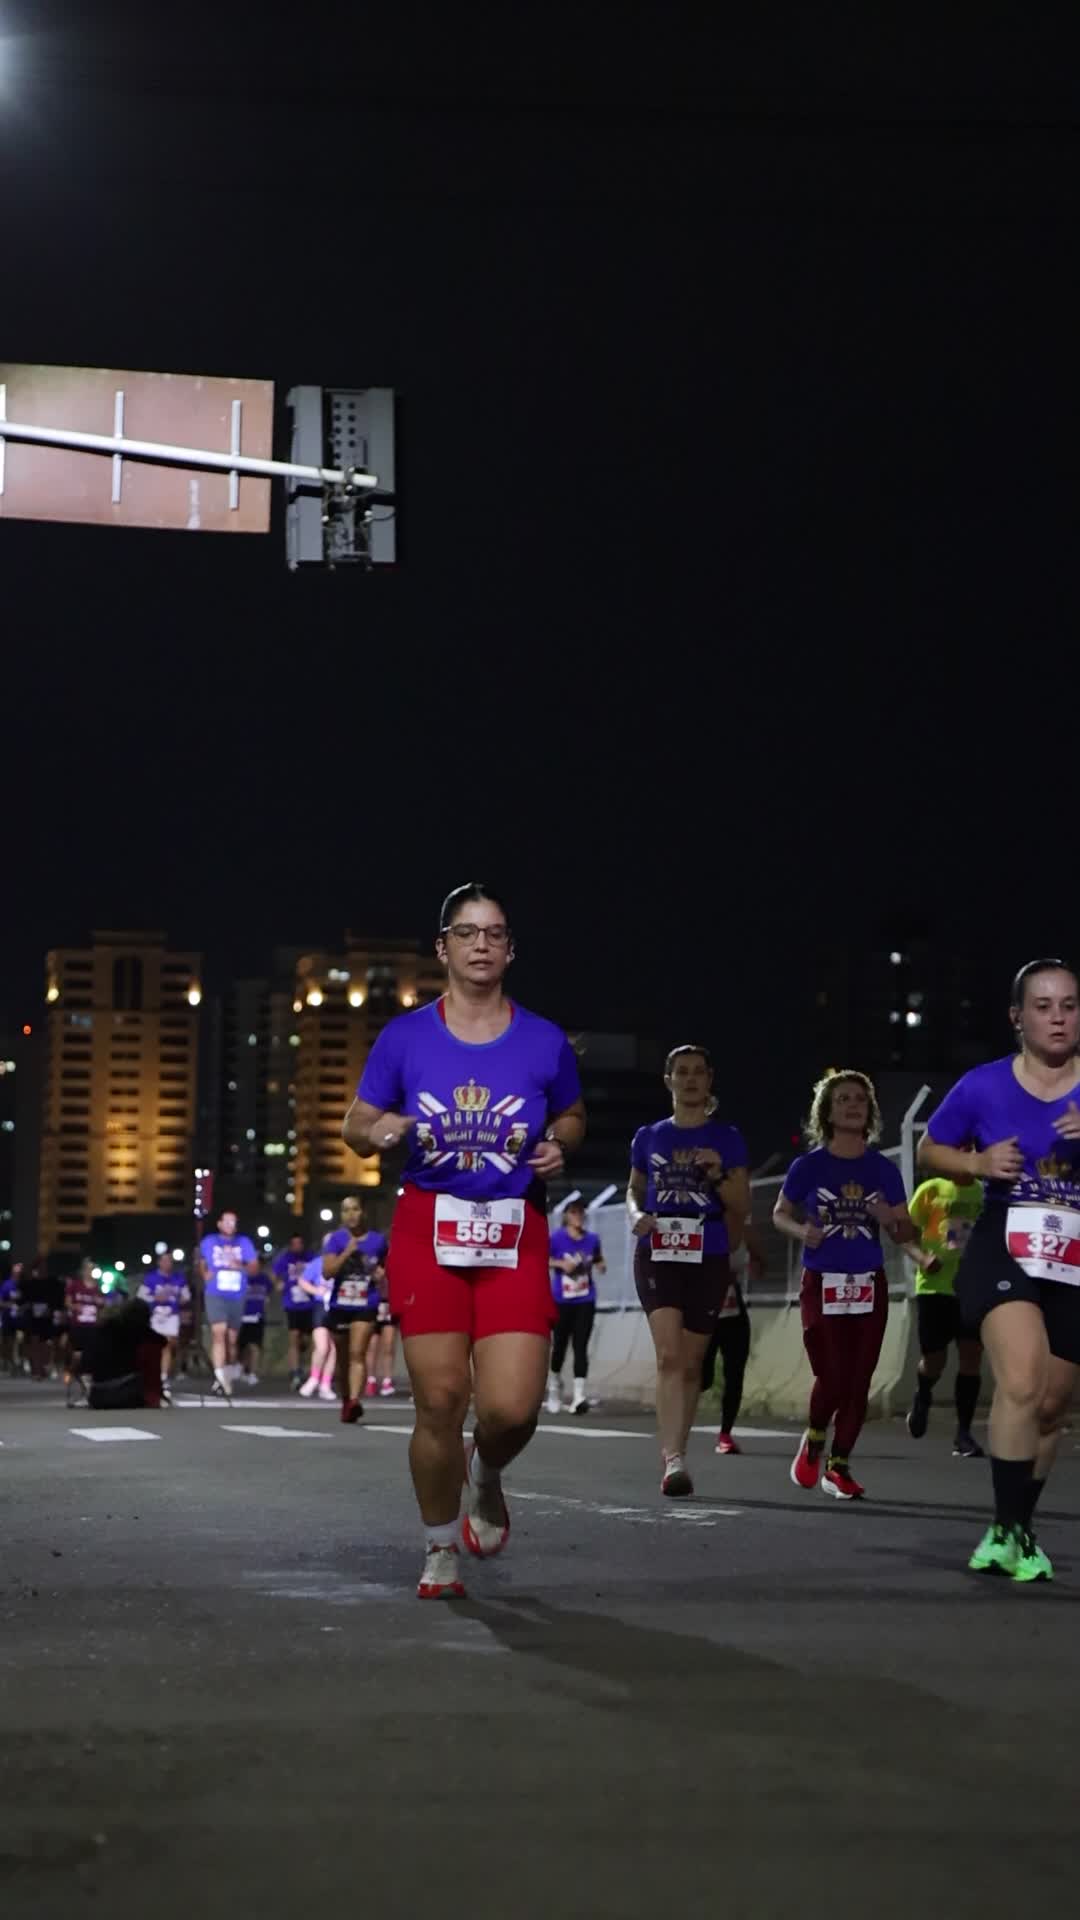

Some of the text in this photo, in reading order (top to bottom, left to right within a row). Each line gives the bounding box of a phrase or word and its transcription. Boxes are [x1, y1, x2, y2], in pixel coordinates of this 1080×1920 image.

[440, 1111, 503, 1128] MARVIN
[443, 1129, 498, 1144] NIGHT RUN
[456, 1221, 503, 1244] 556
[661, 1233, 690, 1247] 604
[1027, 1232, 1072, 1258] 327
[835, 1286, 861, 1299] 539
